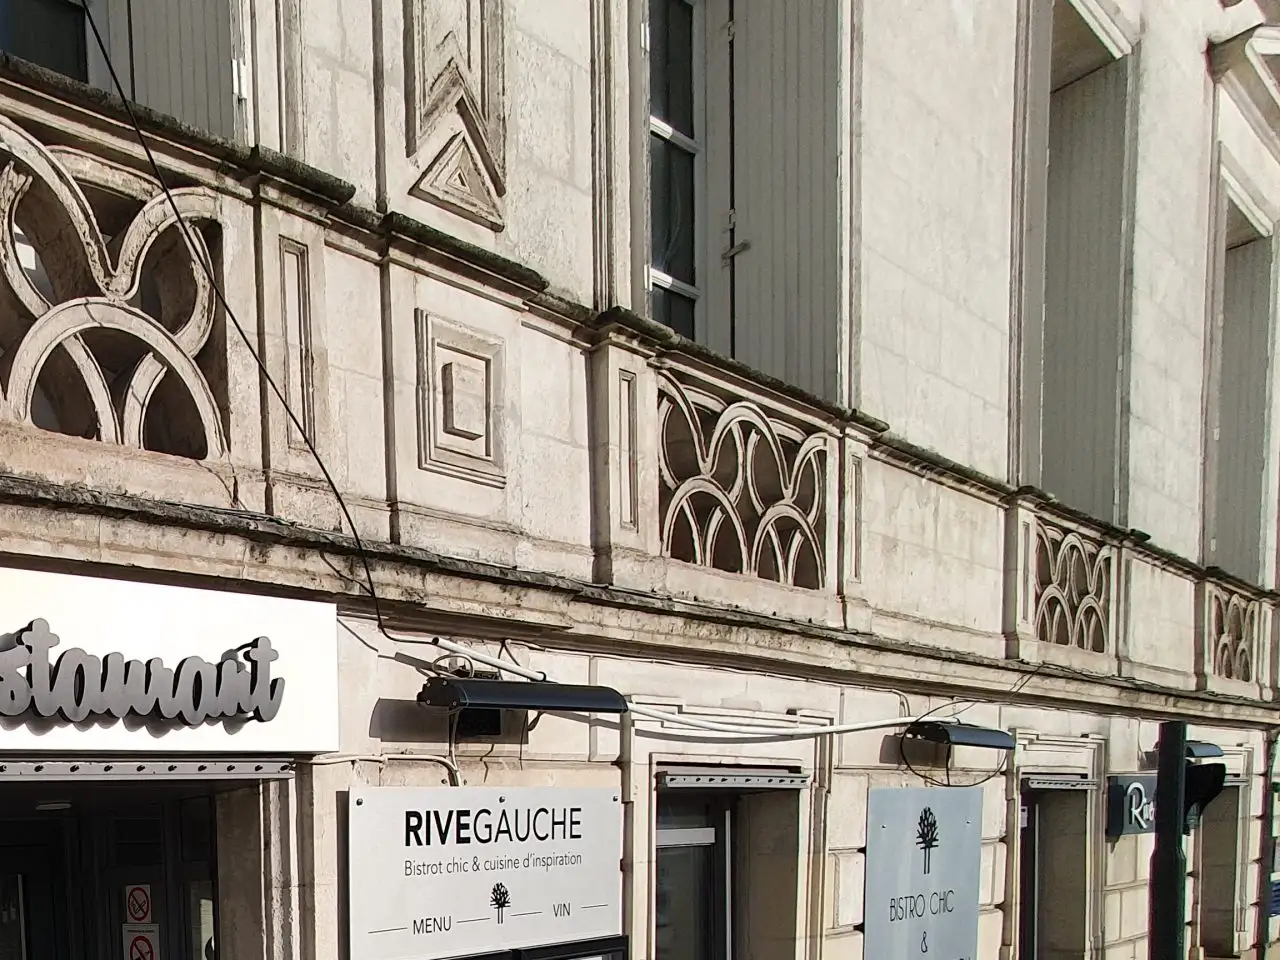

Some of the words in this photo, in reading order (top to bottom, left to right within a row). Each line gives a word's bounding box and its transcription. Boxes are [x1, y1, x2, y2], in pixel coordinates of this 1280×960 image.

[404, 806, 583, 847] RIVEGAUCHE
[404, 860, 443, 876] Bistrot
[446, 857, 469, 873] chic
[471, 856, 481, 871] &
[483, 854, 520, 871] cuisine
[522, 851, 582, 872] d'inspiration
[552, 902, 571, 918] VIN
[889, 893, 926, 922] BISTRO
[929, 889, 955, 915] CHIC
[412, 916, 452, 935] MENU
[920, 930, 928, 954] &
